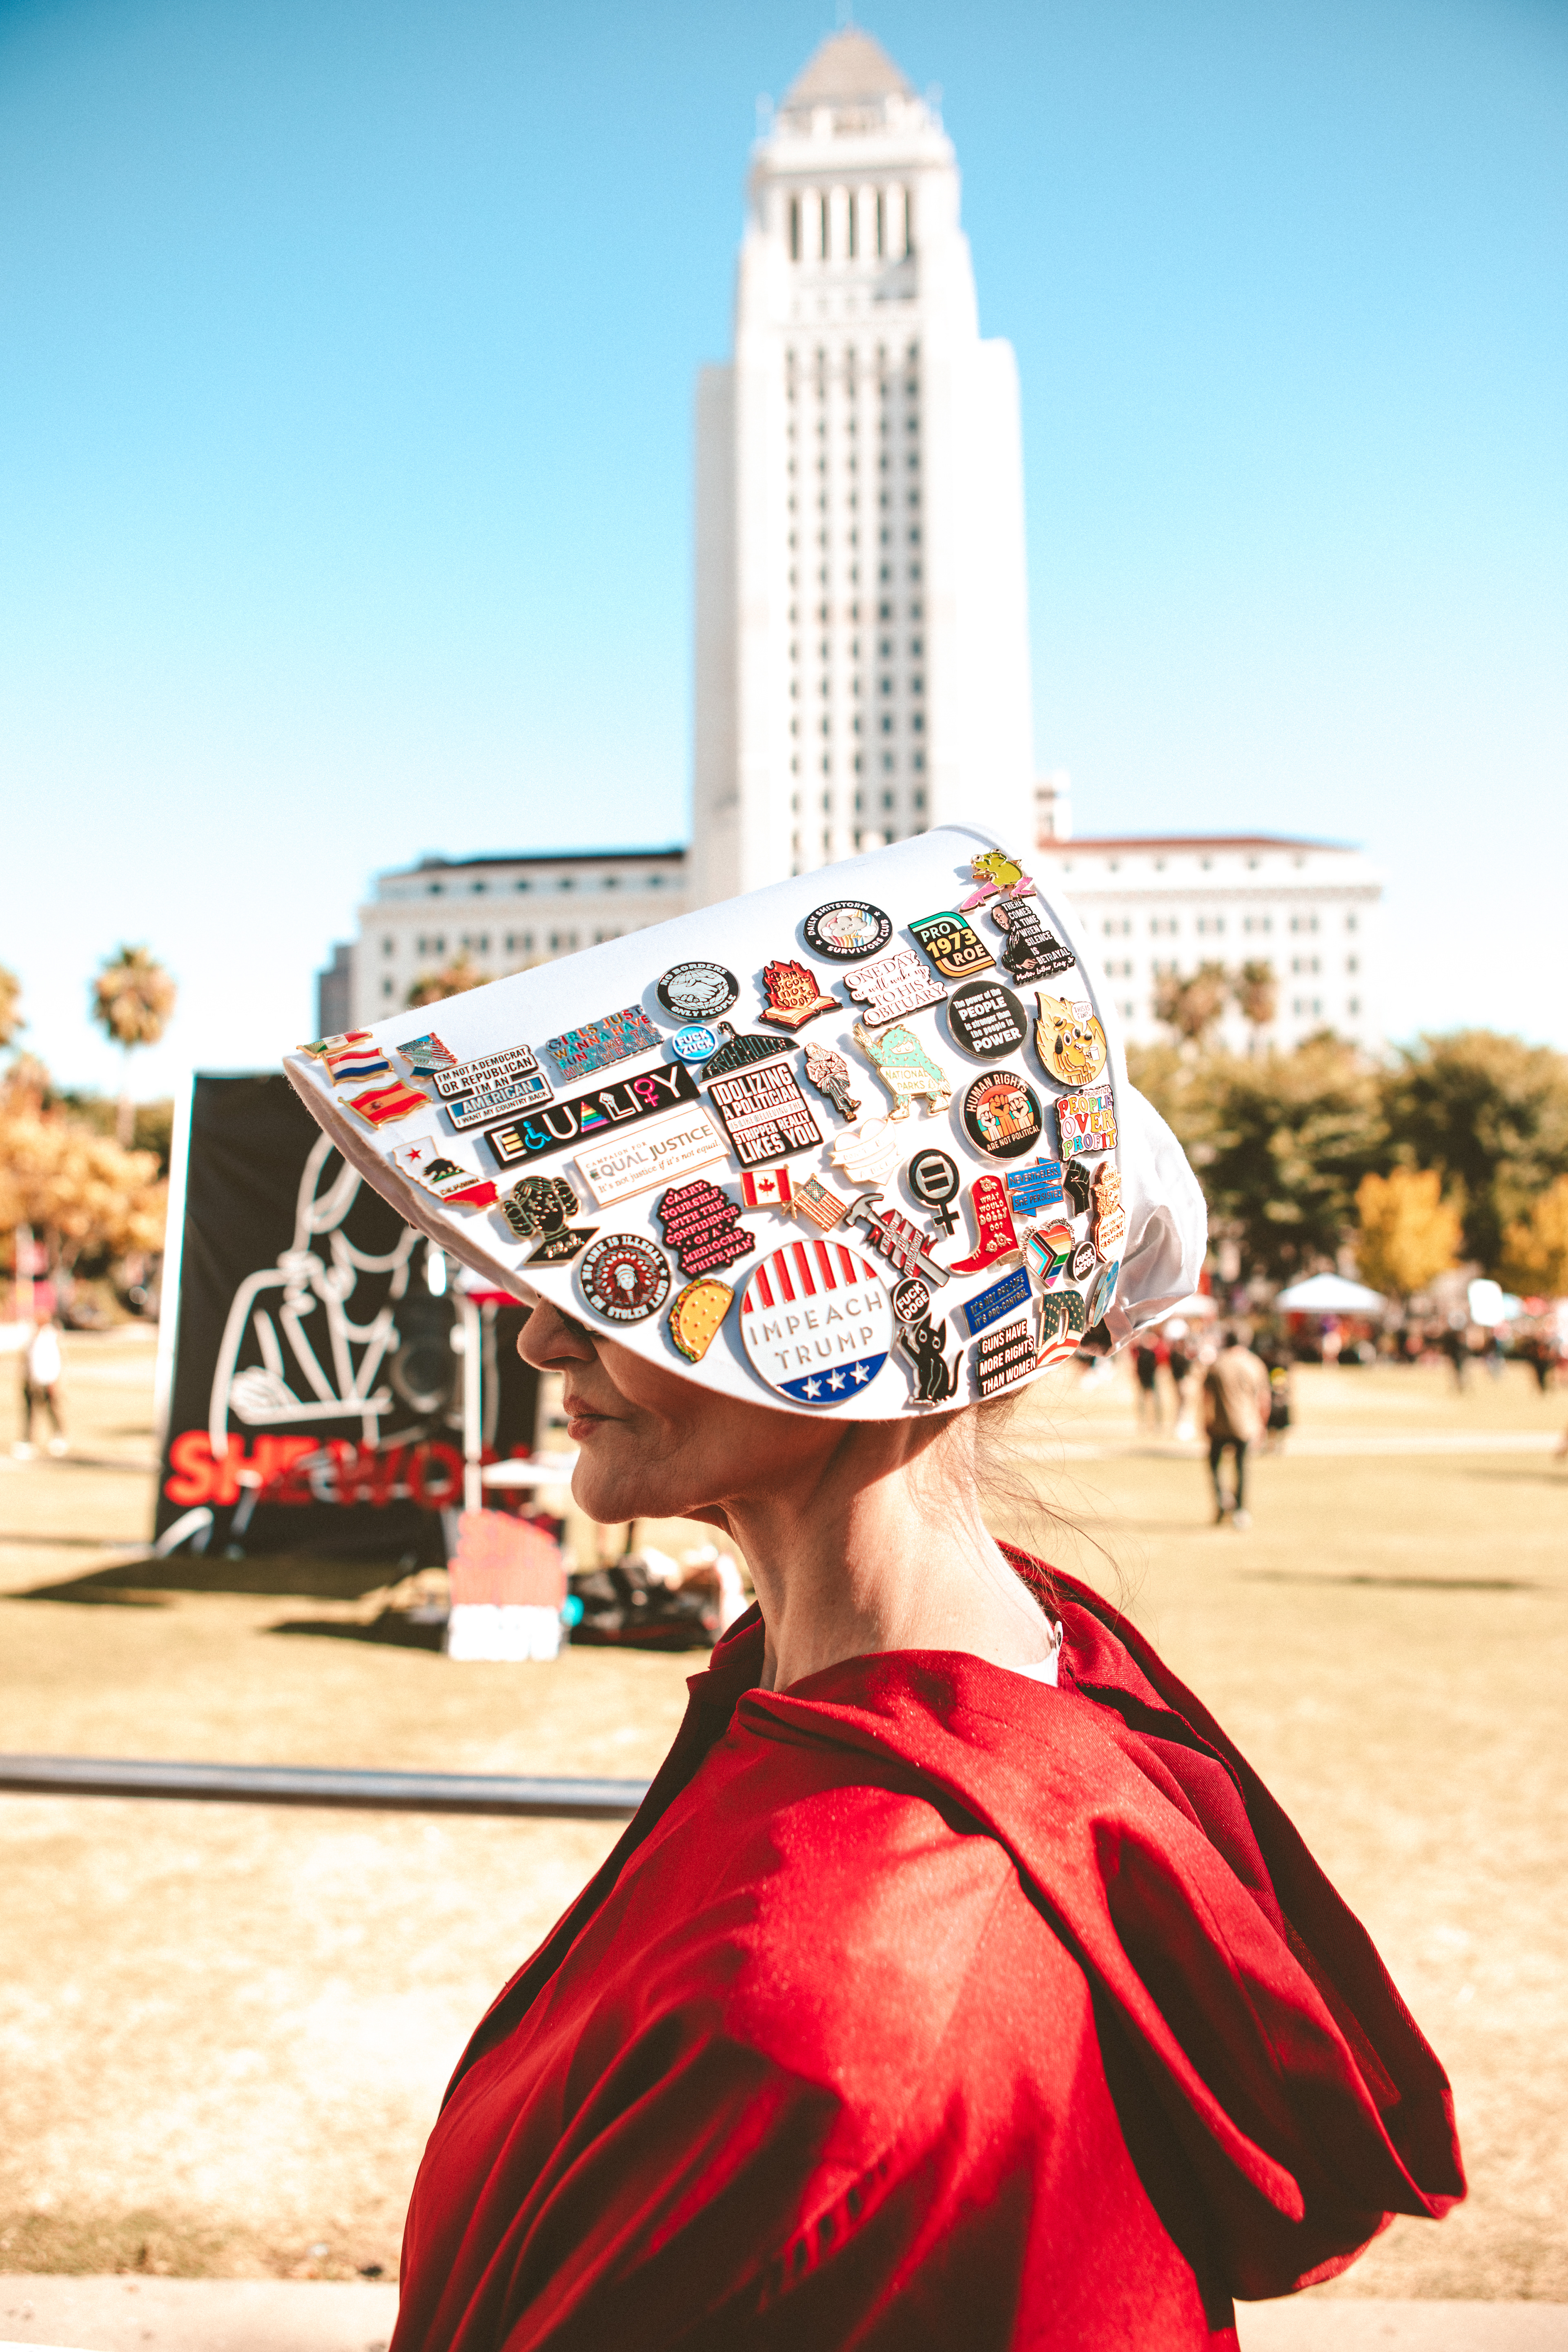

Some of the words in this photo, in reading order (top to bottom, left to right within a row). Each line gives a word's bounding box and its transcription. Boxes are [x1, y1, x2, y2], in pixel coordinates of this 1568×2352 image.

[1002, 900, 1024, 911] THERE
[1008, 906, 1031, 920] COMES
[807, 916, 818, 935] DAILY
[816, 902, 870, 916] SHITSTORM
[1019, 925, 1041, 937] WHEN
[1020, 915, 1039, 926] TIME
[827, 938, 884, 954] SURVIVORS
[880, 919, 889, 937] CLUB
[920, 923, 950, 942] PRO
[926, 929, 977, 958] 1973
[1025, 931, 1053, 946] SILENCE
[953, 944, 986, 965] ROE
[1031, 947, 1040, 956] IS
[1036, 948, 1070, 964] BETRAYAL
[660, 974, 672, 986] NO
[672, 964, 727, 975] BORDERS
[849, 967, 883, 985] ONE
[882, 954, 915, 973] DAY
[869, 978, 888, 992] will
[891, 968, 913, 984] wake
[915, 969, 926, 978] up
[1017, 972, 1035, 980] Martin
[1036, 965, 1051, 974] Luther
[783, 986, 806, 998] not
[868, 985, 943, 1021] OBITUARY
[871, 991, 895, 1007] TO
[895, 980, 923, 997] HIS
[953, 1001, 965, 1009] The
[964, 994, 984, 1006] power
[671, 1006, 698, 1016] ONLY
[702, 995, 736, 1015] PEOPLE
[958, 996, 1007, 1020] PEOPLE
[548, 1025, 597, 1049] GIRLS
[603, 1006, 641, 1029] JUST
[971, 1029, 983, 1038] the
[983, 1022, 1006, 1035] people
[972, 1014, 997, 1028] stronger
[996, 1010, 1011, 1019] than
[553, 1032, 610, 1059] WANNA
[611, 1016, 650, 1036] HAVE
[676, 1030, 709, 1047] FUCK
[682, 1039, 714, 1054] ZUCK
[973, 1027, 1022, 1052] POWER
[439, 1072, 451, 1082] I'M
[452, 1067, 470, 1077] NOT
[479, 1048, 526, 1069] DEMOCRAT
[564, 1051, 615, 1078] HUMAN
[615, 1032, 661, 1056] RIGHTS
[443, 1082, 459, 1093] OR
[462, 1057, 532, 1086] REPUBLICAN
[476, 1083, 491, 1094] I'M
[494, 1077, 509, 1088] AN
[711, 1065, 793, 1106] IDOLIZING
[886, 1070, 928, 1080] NATIONAL
[898, 1081, 925, 1091] PARKS
[463, 1081, 535, 1114] AMERICAN
[722, 1106, 734, 1120] A
[732, 1083, 800, 1117] POLITICIAN
[966, 1077, 993, 1112] HUMAN
[993, 1074, 1029, 1093] RIGHTS
[1085, 1087, 1109, 1097] PRIORITIZE
[462, 1113, 481, 1123] WANT
[496, 1098, 527, 1112] COUNTRY
[529, 1091, 548, 1104] BACK
[738, 1116, 753, 1127] LIKE
[755, 1105, 788, 1122] BELIEVING
[788, 1102, 802, 1111] THE
[1058, 1092, 1113, 1120] PEOPLE
[733, 1121, 778, 1145] STRIPPER
[777, 1110, 810, 1131] REALLY
[1062, 1109, 1114, 1138] OVER
[737, 1133, 785, 1163] LIKES
[784, 1121, 820, 1147] YOU
[987, 1141, 999, 1152] ARE
[999, 1136, 1011, 1146] NOT
[1012, 1125, 1040, 1141] POLITICAL
[1063, 1129, 1116, 1158] PROFIT
[586, 1149, 628, 1168] CAMPAIGN
[632, 1142, 647, 1150] FOR
[589, 1152, 648, 1181] EQUAL
[650, 1125, 713, 1161] JUSTICE
[598, 1183, 613, 1193] It's
[615, 1176, 629, 1186] not
[630, 1165, 657, 1183] justice
[659, 1160, 666, 1170] if
[666, 1156, 680, 1167] it's
[682, 1149, 695, 1159] not
[697, 1140, 721, 1154] equal.
[1009, 1167, 1060, 1185] NEVERTHELESS,
[1103, 1170, 1117, 1182] RESIST
[660, 1188, 719, 1220] YOURSELF
[665, 1182, 703, 1205] CARRY
[980, 1192, 999, 1204] WHAT
[1015, 1196, 1028, 1207] SHE
[1030, 1189, 1062, 1204] PERSISTED
[668, 1211, 701, 1229] WITH
[699, 1200, 724, 1216] THE
[979, 1200, 1003, 1213] WOULD
[979, 1207, 1007, 1225] DOLLY
[666, 1206, 739, 1244] CONFIDENCE
[694, 1232, 708, 1244] OF
[712, 1228, 721, 1238] A
[883, 1221, 900, 1247] SMASH
[990, 1222, 1002, 1231] DO?
[1100, 1221, 1123, 1241] PREVENT
[586, 1242, 607, 1263] ONE
[606, 1236, 619, 1247] IS
[621, 1236, 664, 1265] ILLEGAL
[683, 1229, 744, 1263] MEDIOCRE
[898, 1234, 909, 1251] THE
[1100, 1230, 1123, 1250] FASCISM
[686, 1252, 726, 1274] WHITE
[724, 1239, 753, 1257] MAN
[905, 1234, 922, 1276] PATRIARCHY
[1075, 1255, 1095, 1276] BEZOS
[1076, 1248, 1092, 1266] FUCK
[582, 1264, 593, 1280] NO
[590, 1295, 606, 1310] ON
[607, 1305, 649, 1319] STOLEN
[649, 1280, 668, 1308] LAND
[897, 1282, 923, 1310] FUCK
[902, 1291, 929, 1319] DOGE
[971, 1301, 983, 1314] IT'S
[984, 1292, 996, 1306] NOT
[997, 1274, 1025, 1297] PRO-LIFE
[750, 1291, 883, 1345] IMPEACH
[975, 1314, 987, 1328] IT'S
[988, 1288, 1028, 1320] PRO-CONTROL
[775, 1327, 873, 1369] TRUMP
[982, 1332, 1004, 1353] GUNS
[1006, 1321, 1026, 1343] HAVE
[980, 1352, 1004, 1376] MORE
[1005, 1338, 1033, 1363] RIGHTS
[982, 1372, 1004, 1394] THAN
[1006, 1356, 1036, 1383] WOMEN
